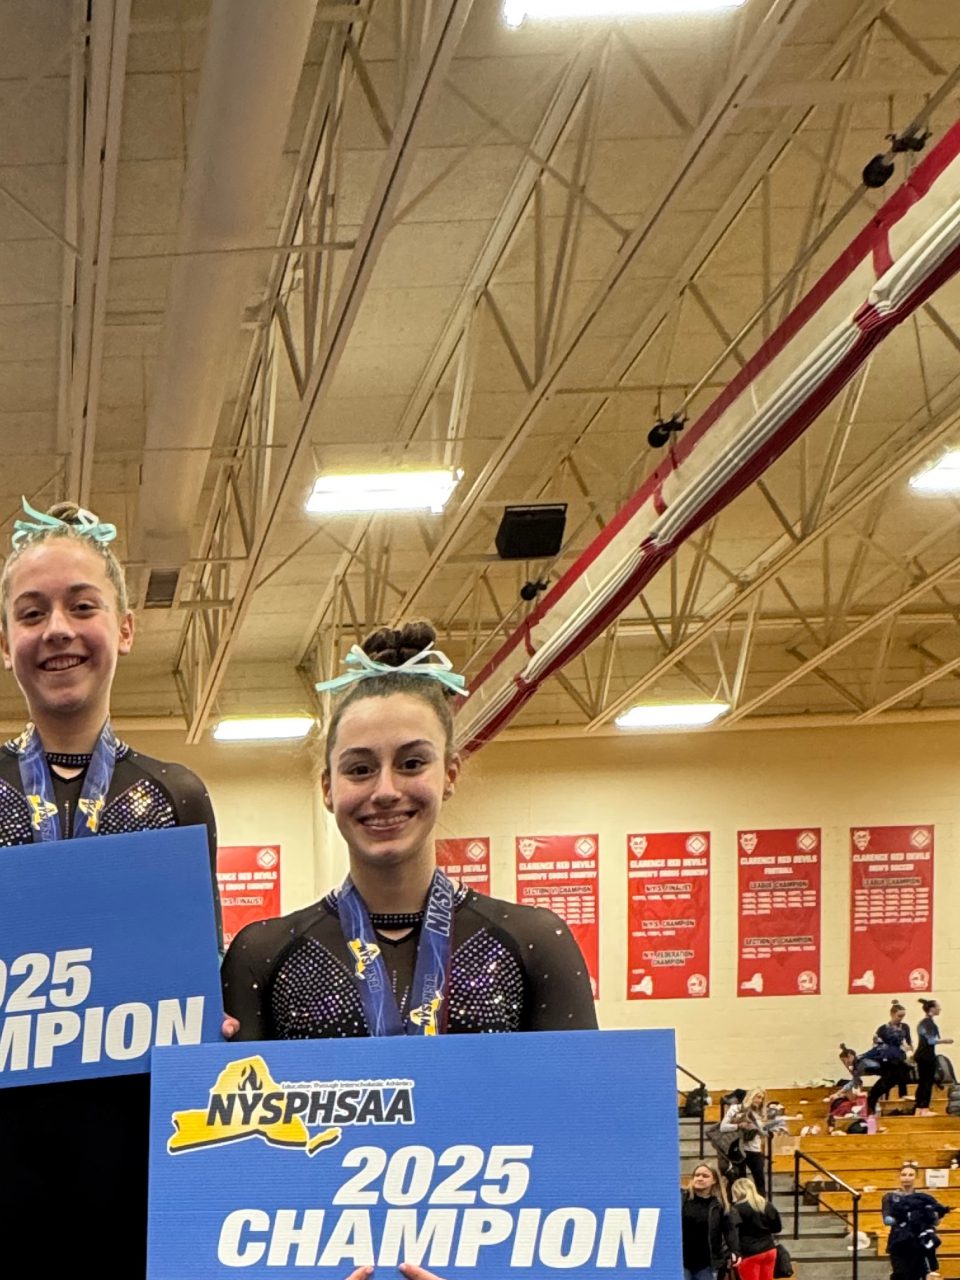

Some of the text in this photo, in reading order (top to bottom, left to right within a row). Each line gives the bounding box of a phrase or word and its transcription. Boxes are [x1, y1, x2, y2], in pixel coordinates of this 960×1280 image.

[207, 1089, 413, 1126] NYSPHSAA
[332, 1144, 534, 1206] 2025
[216, 1207, 660, 1269] CHAMPION
